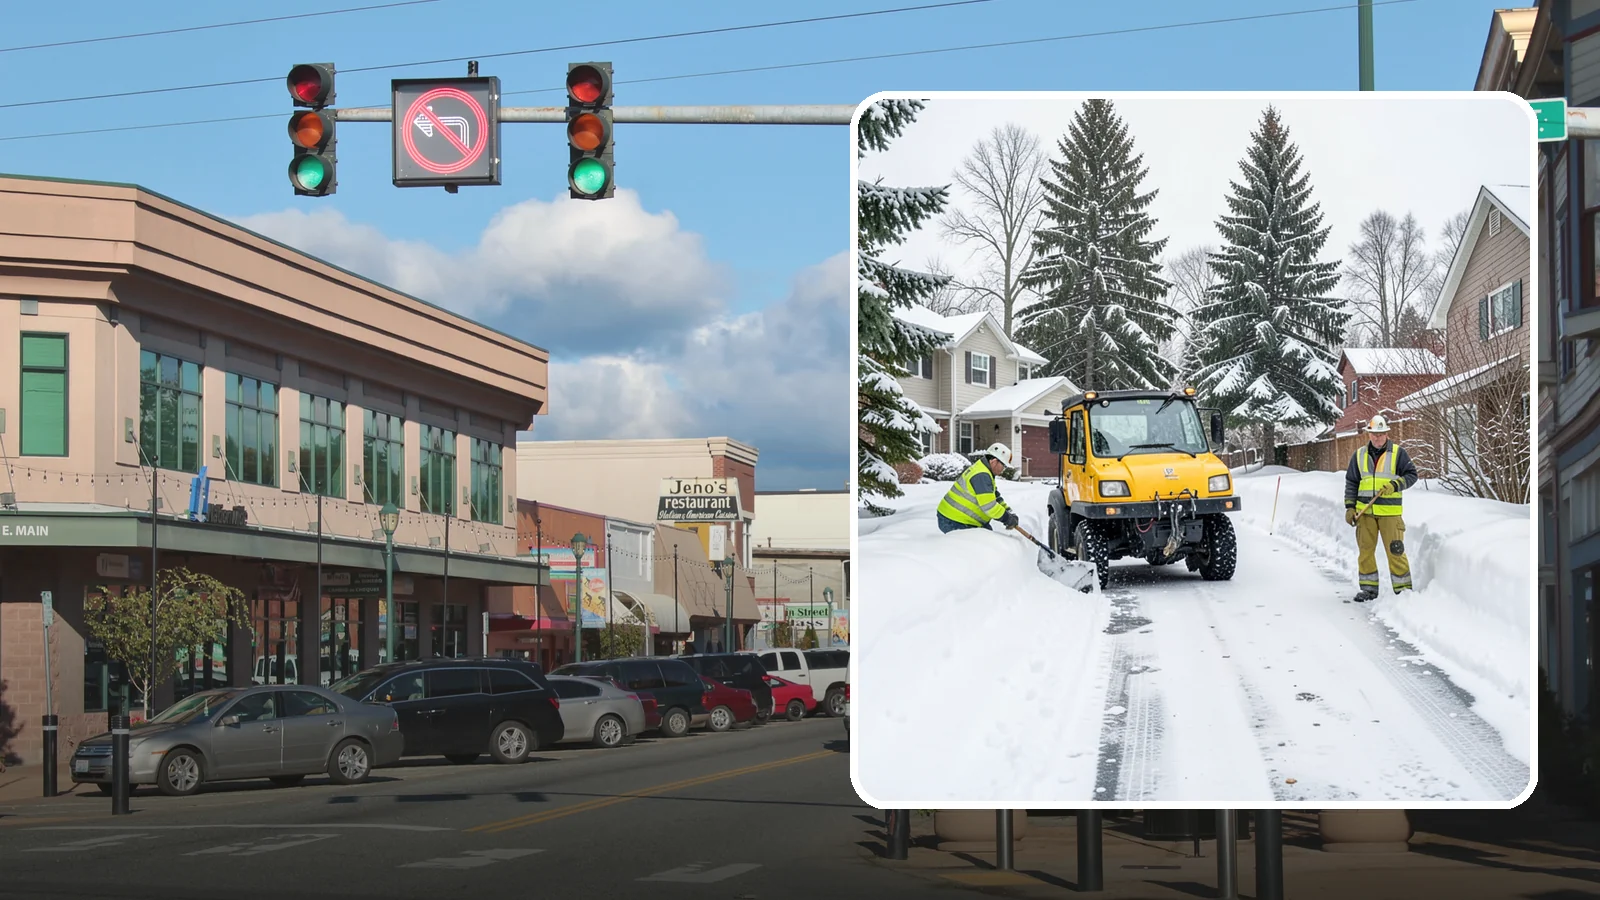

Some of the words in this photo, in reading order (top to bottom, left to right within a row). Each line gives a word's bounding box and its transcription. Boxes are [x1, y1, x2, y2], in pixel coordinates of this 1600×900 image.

[669, 480, 727, 494] Jeno's
[665, 496, 731, 509] restaurant
[658, 510, 682, 519] Italian
[686, 509, 714, 519] American
[715, 509, 738, 519] Cuisine
[2, 525, 13, 536] E.
[15, 525, 49, 536] MAIN
[786, 608, 795, 616] in
[797, 608, 828, 616] Street
